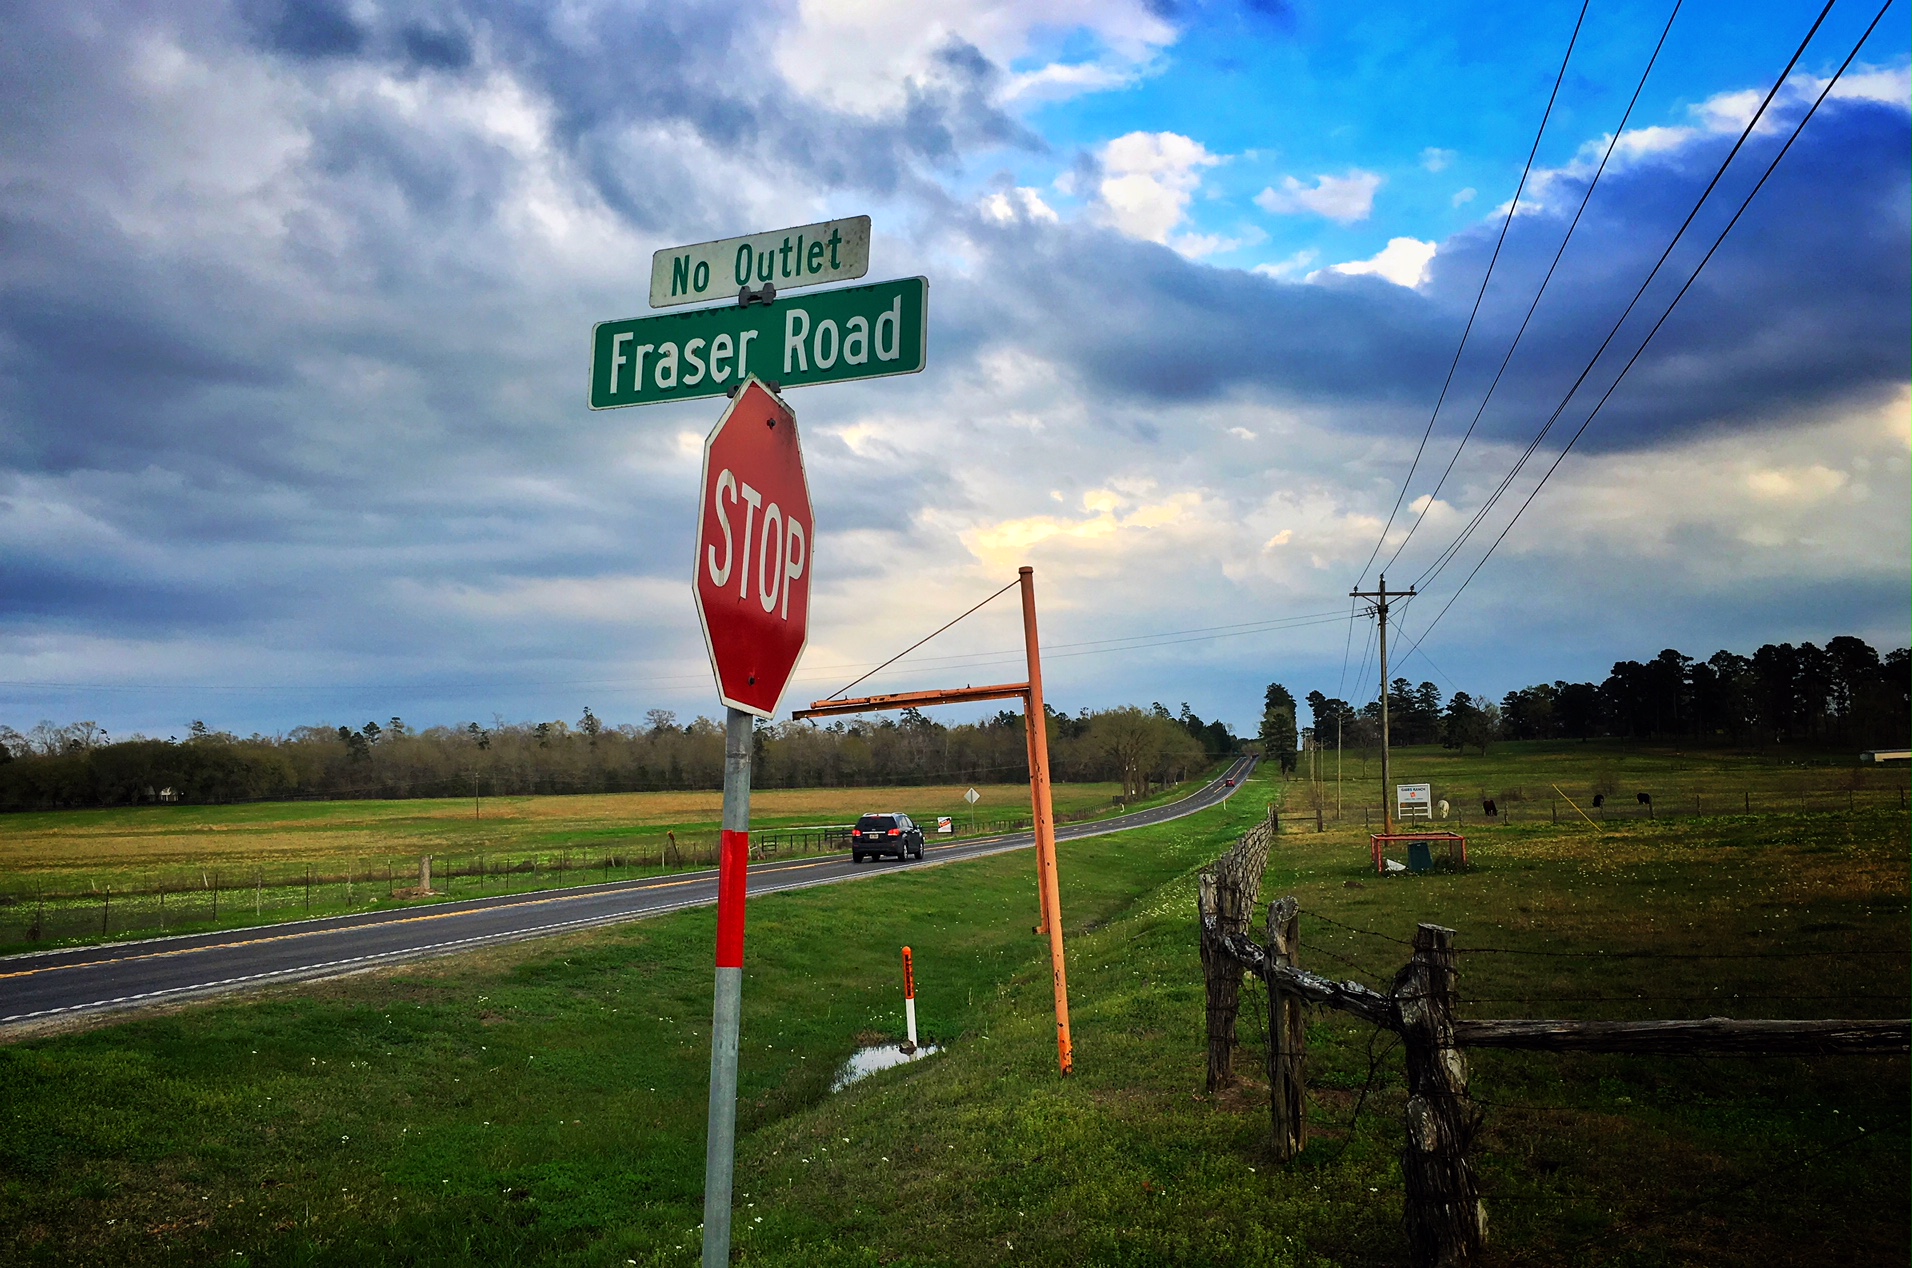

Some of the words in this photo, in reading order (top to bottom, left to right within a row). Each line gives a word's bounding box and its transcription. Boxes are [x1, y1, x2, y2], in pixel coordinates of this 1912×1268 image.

[671, 254, 710, 297] No
[734, 228, 842, 286] Outlet
[609, 327, 759, 394] Fraser
[783, 294, 902, 374] Road
[708, 468, 806, 621] STOP
